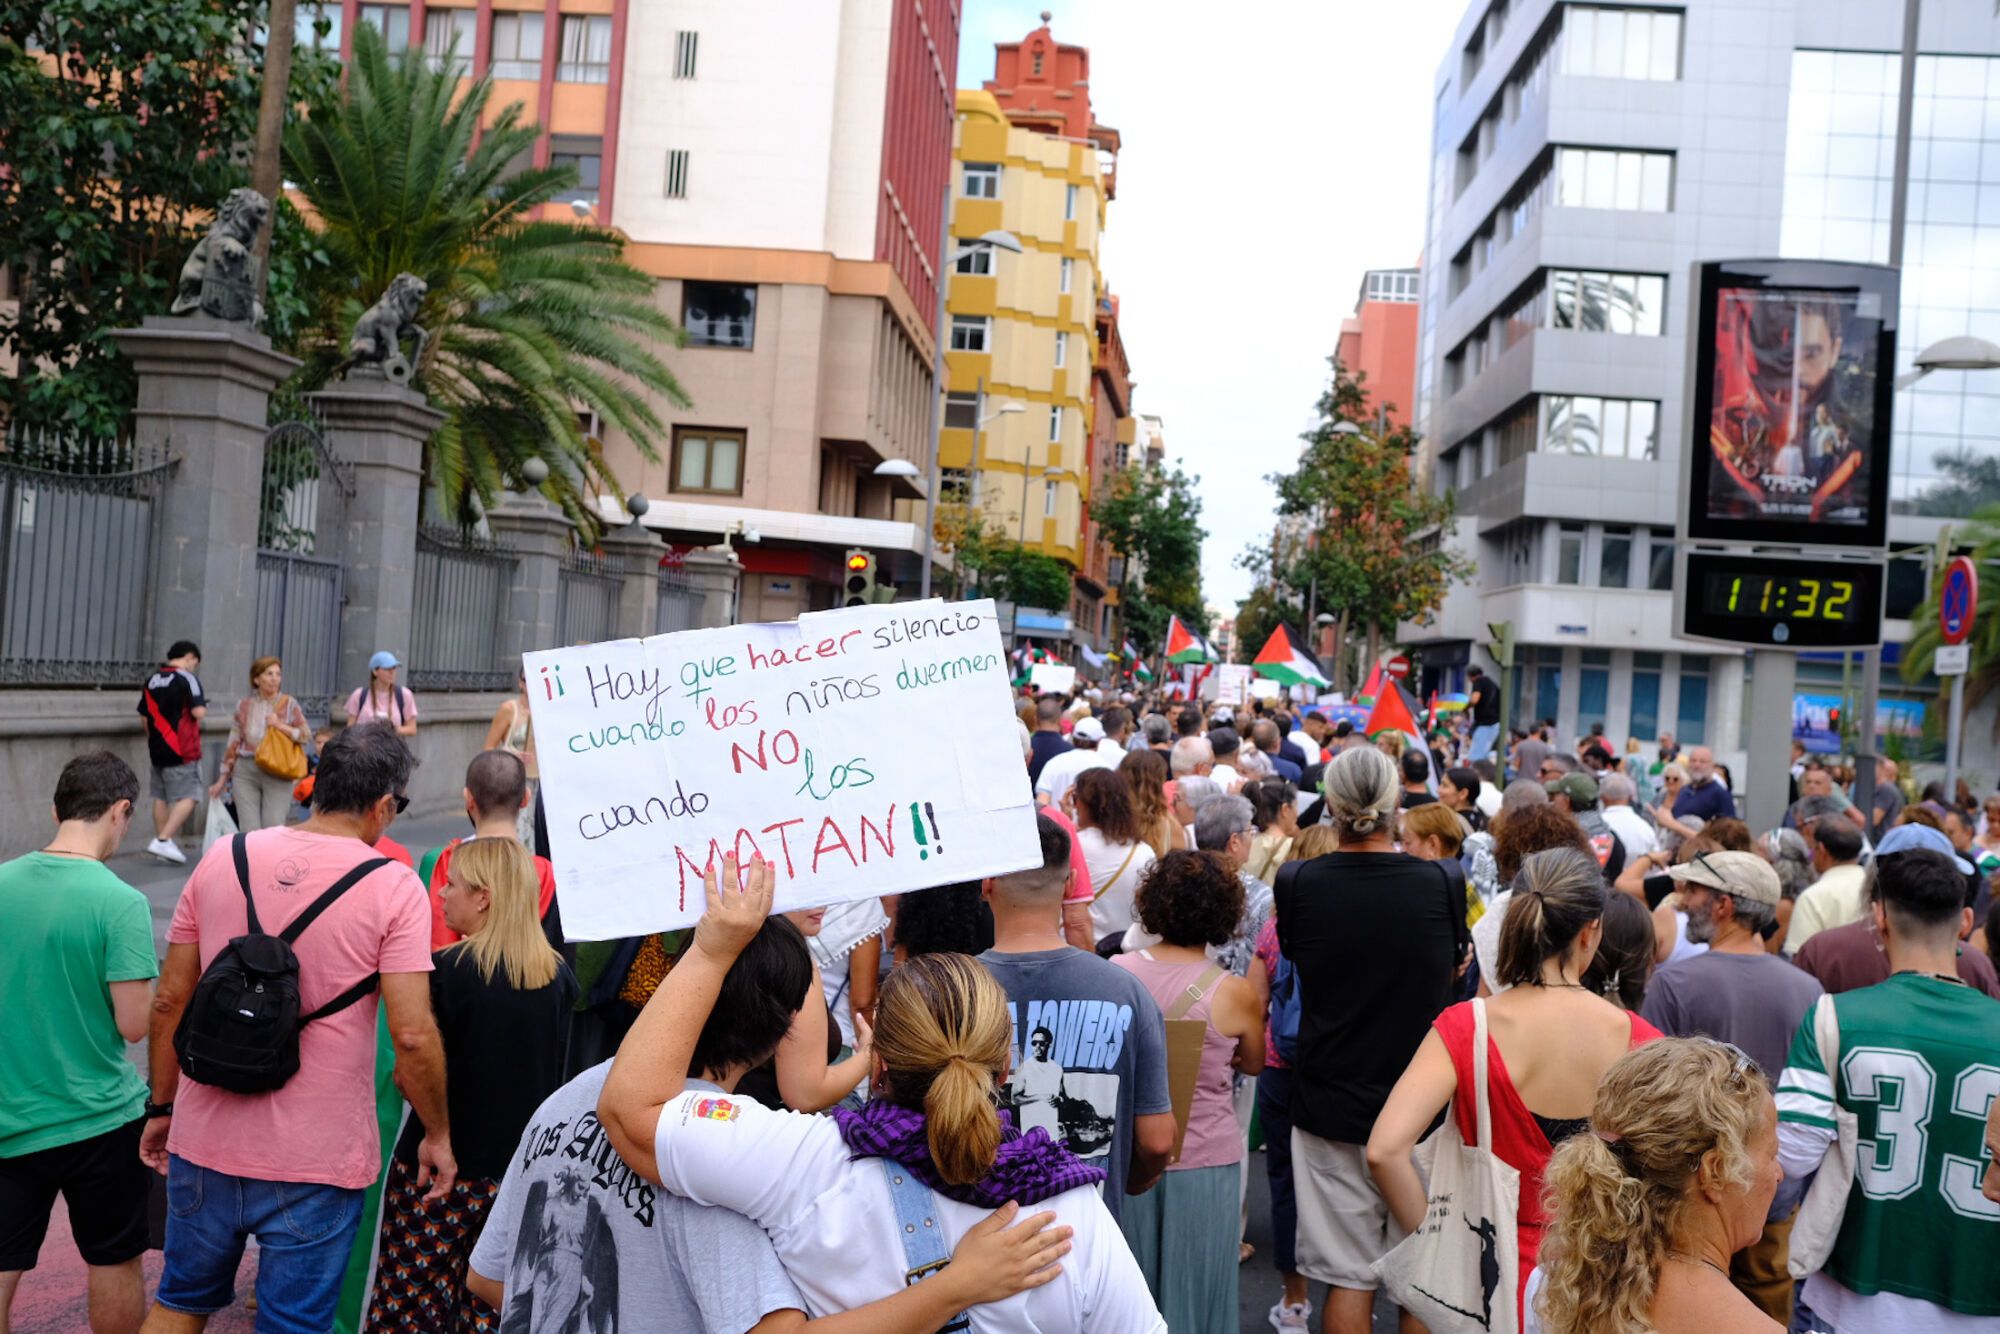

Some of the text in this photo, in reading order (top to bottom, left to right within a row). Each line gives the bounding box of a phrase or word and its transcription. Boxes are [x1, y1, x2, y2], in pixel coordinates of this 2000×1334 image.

[1728, 577, 1852, 619] 11:32
[568, 653, 998, 753] cuando los niños duermen
[586, 663, 672, 726] Hay
[680, 656, 737, 710] que
[747, 629, 862, 670] hacer
[873, 612, 981, 649] silencio
[731, 729, 800, 774] NO
[578, 748, 875, 840] cuando los
[1023, 999, 1133, 1070] TOWERS
